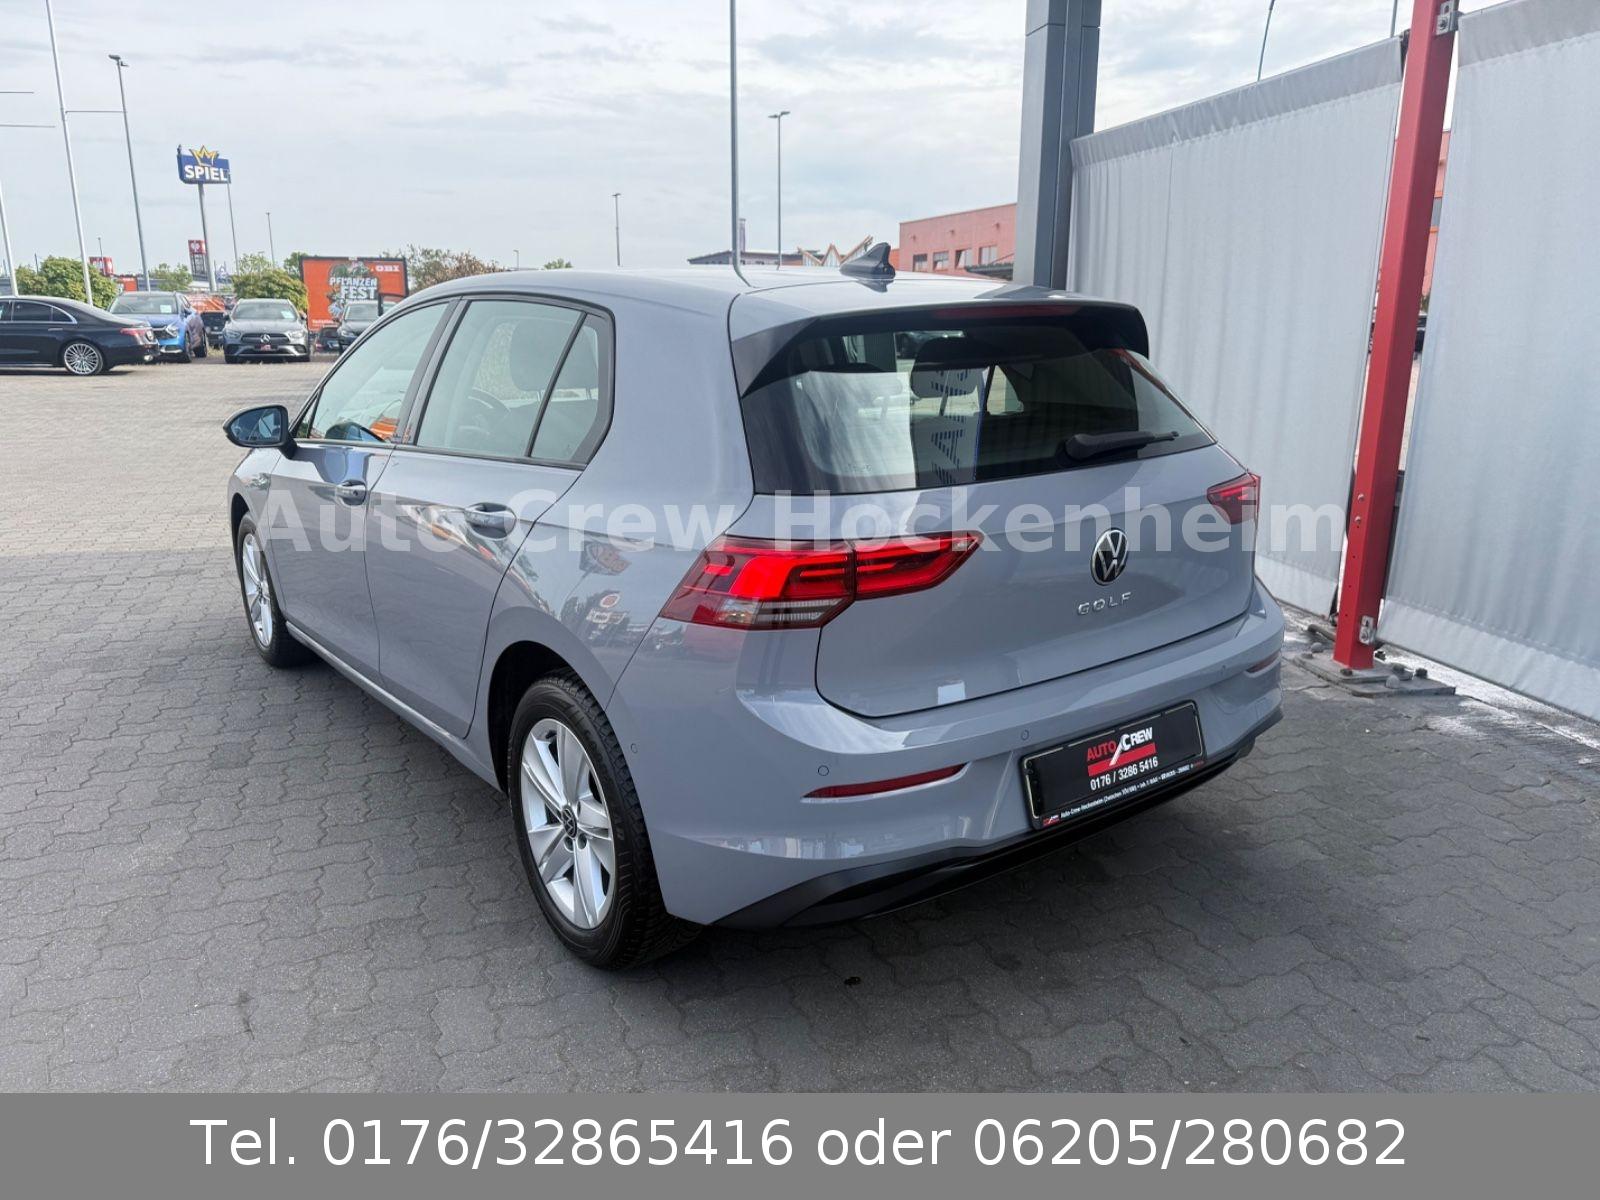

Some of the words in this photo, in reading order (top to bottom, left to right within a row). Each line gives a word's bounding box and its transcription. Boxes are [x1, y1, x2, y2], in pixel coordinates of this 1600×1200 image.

[184, 165, 228, 181] SPIEL
[375, 264, 400, 272] OBI
[329, 276, 378, 287] PFLANZEN
[341, 286, 378, 299] FEST
[1077, 592, 1132, 615] GOLF
[1087, 740, 1117, 761] AUTO
[1115, 727, 1153, 752] CREW
[1090, 773, 1111, 791] 0176
[1113, 771, 1117, 783] /
[1118, 763, 1138, 780] 3286
[1139, 756, 1159, 773] 5416
